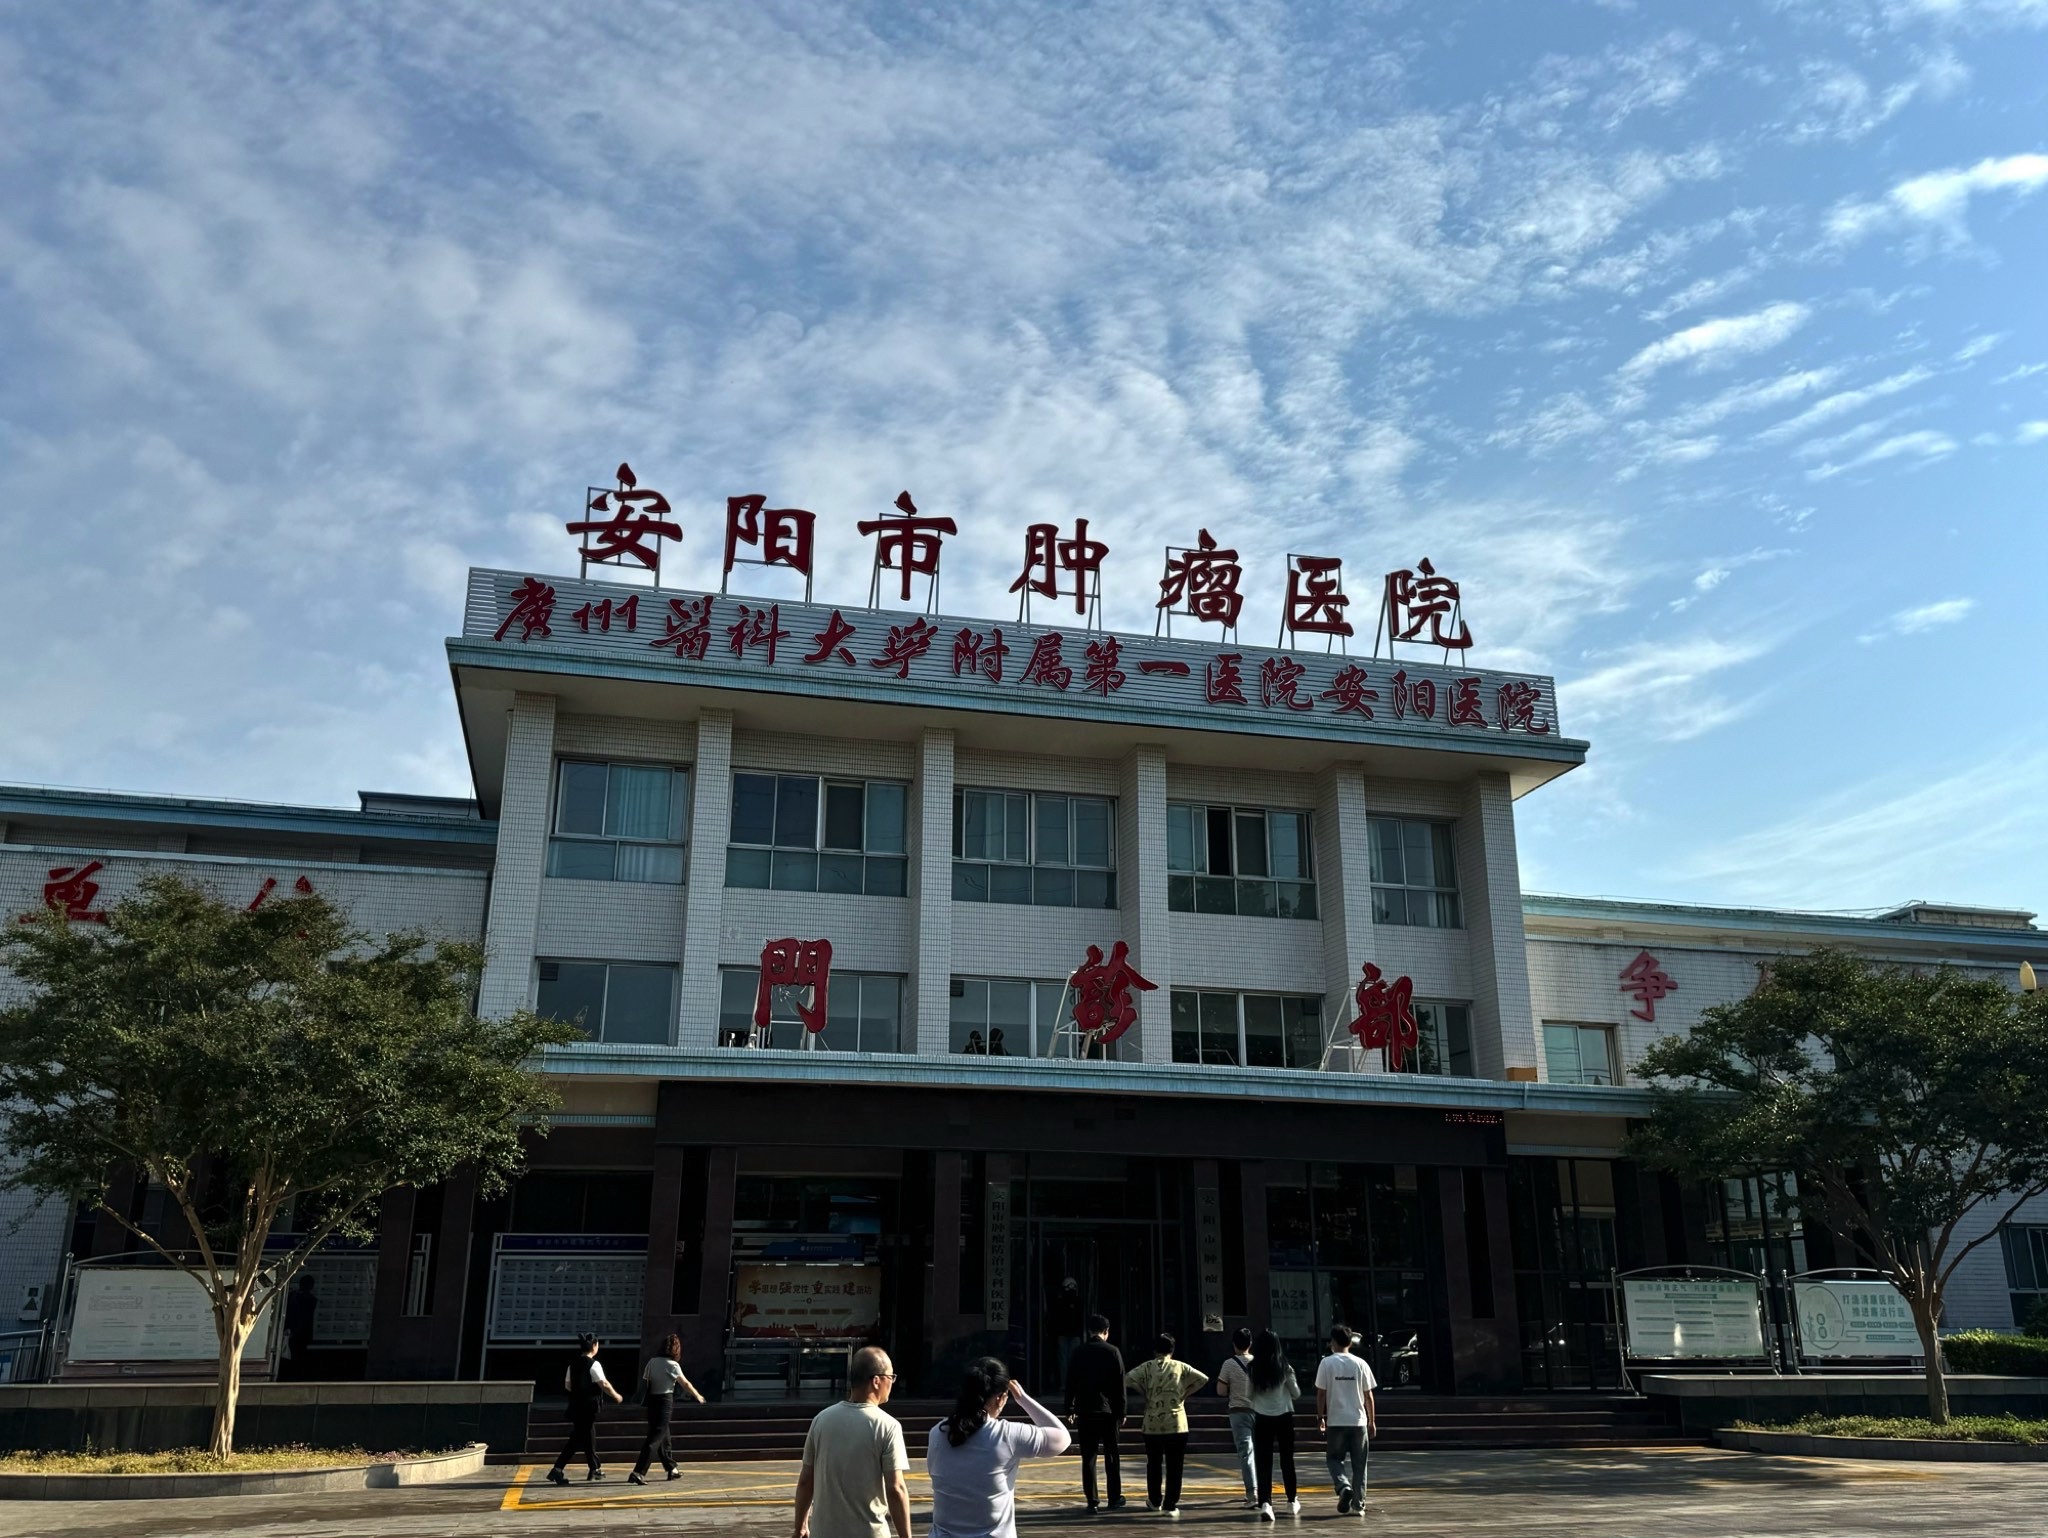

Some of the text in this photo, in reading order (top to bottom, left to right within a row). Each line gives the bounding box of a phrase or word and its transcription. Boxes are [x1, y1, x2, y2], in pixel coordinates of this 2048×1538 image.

[566, 462, 1474, 649] 安阳市肿瘤医院
